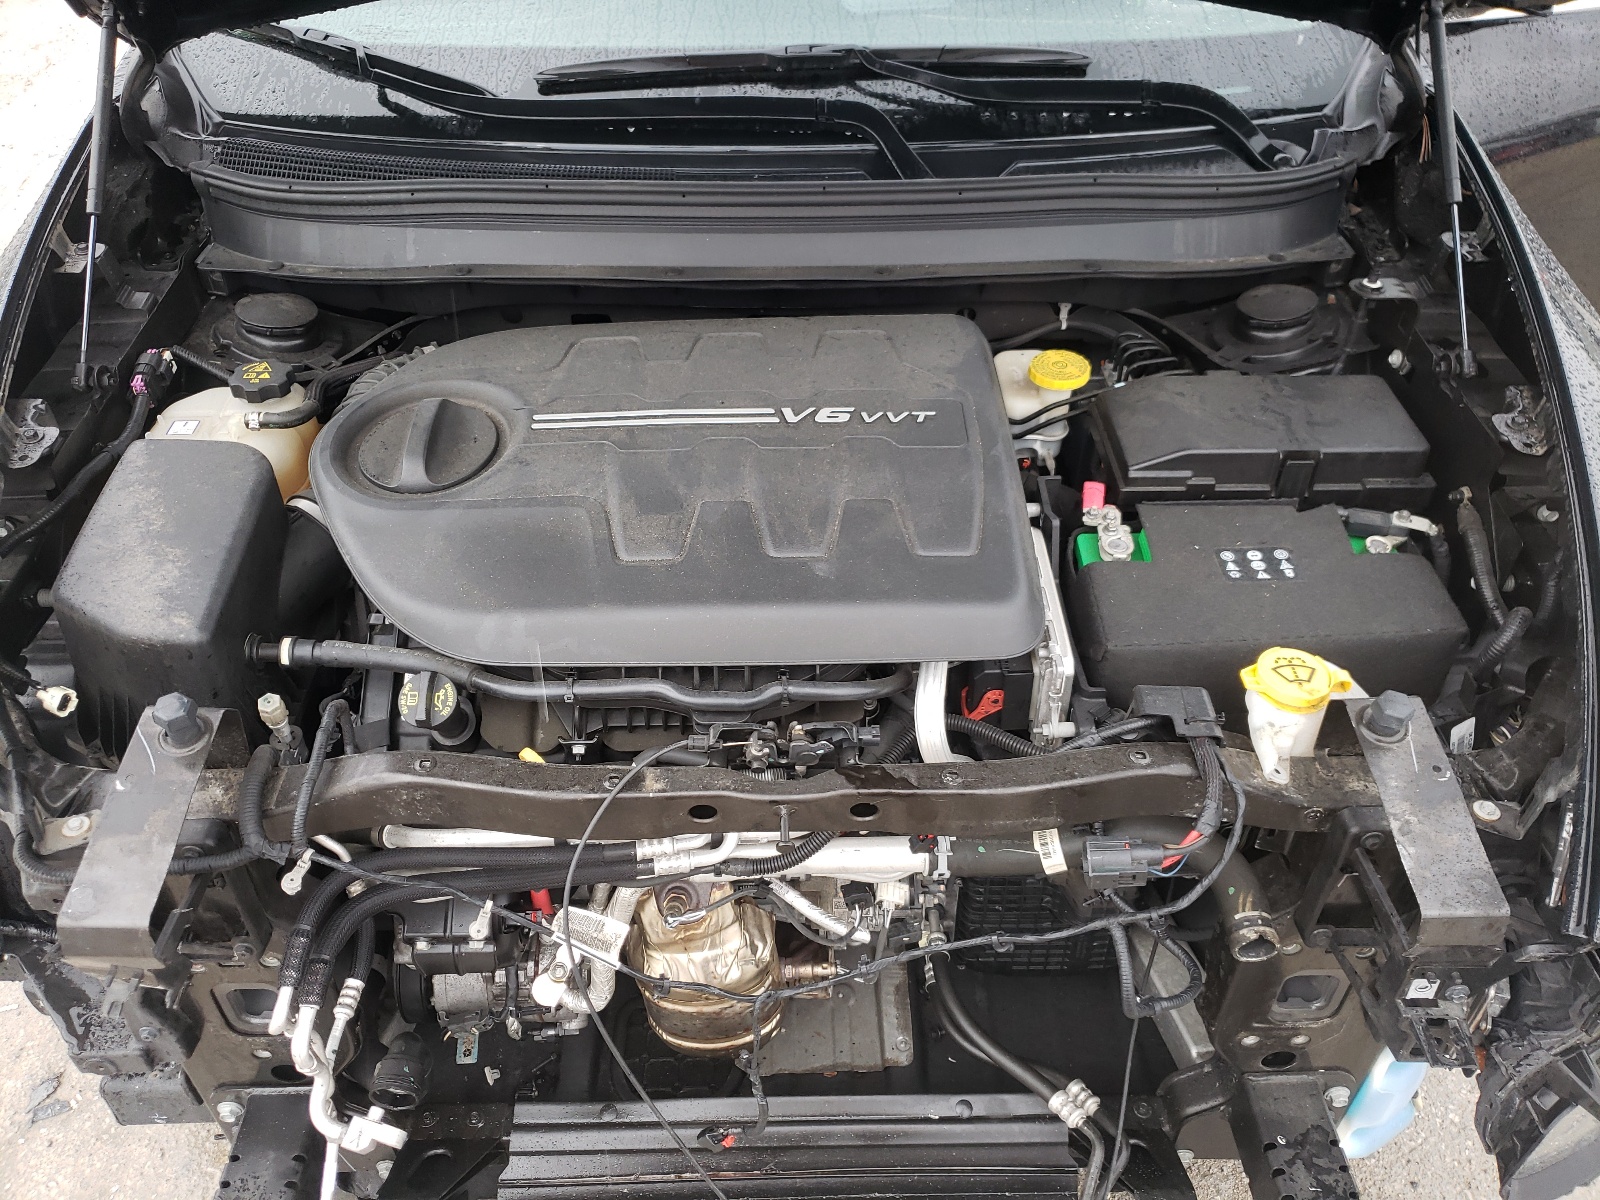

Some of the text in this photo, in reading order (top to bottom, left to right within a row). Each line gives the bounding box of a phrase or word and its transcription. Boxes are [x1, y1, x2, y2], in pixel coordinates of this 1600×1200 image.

[781, 407, 936, 423] V6 VVT
[440, 682, 454, 716] ENGINE OIL
